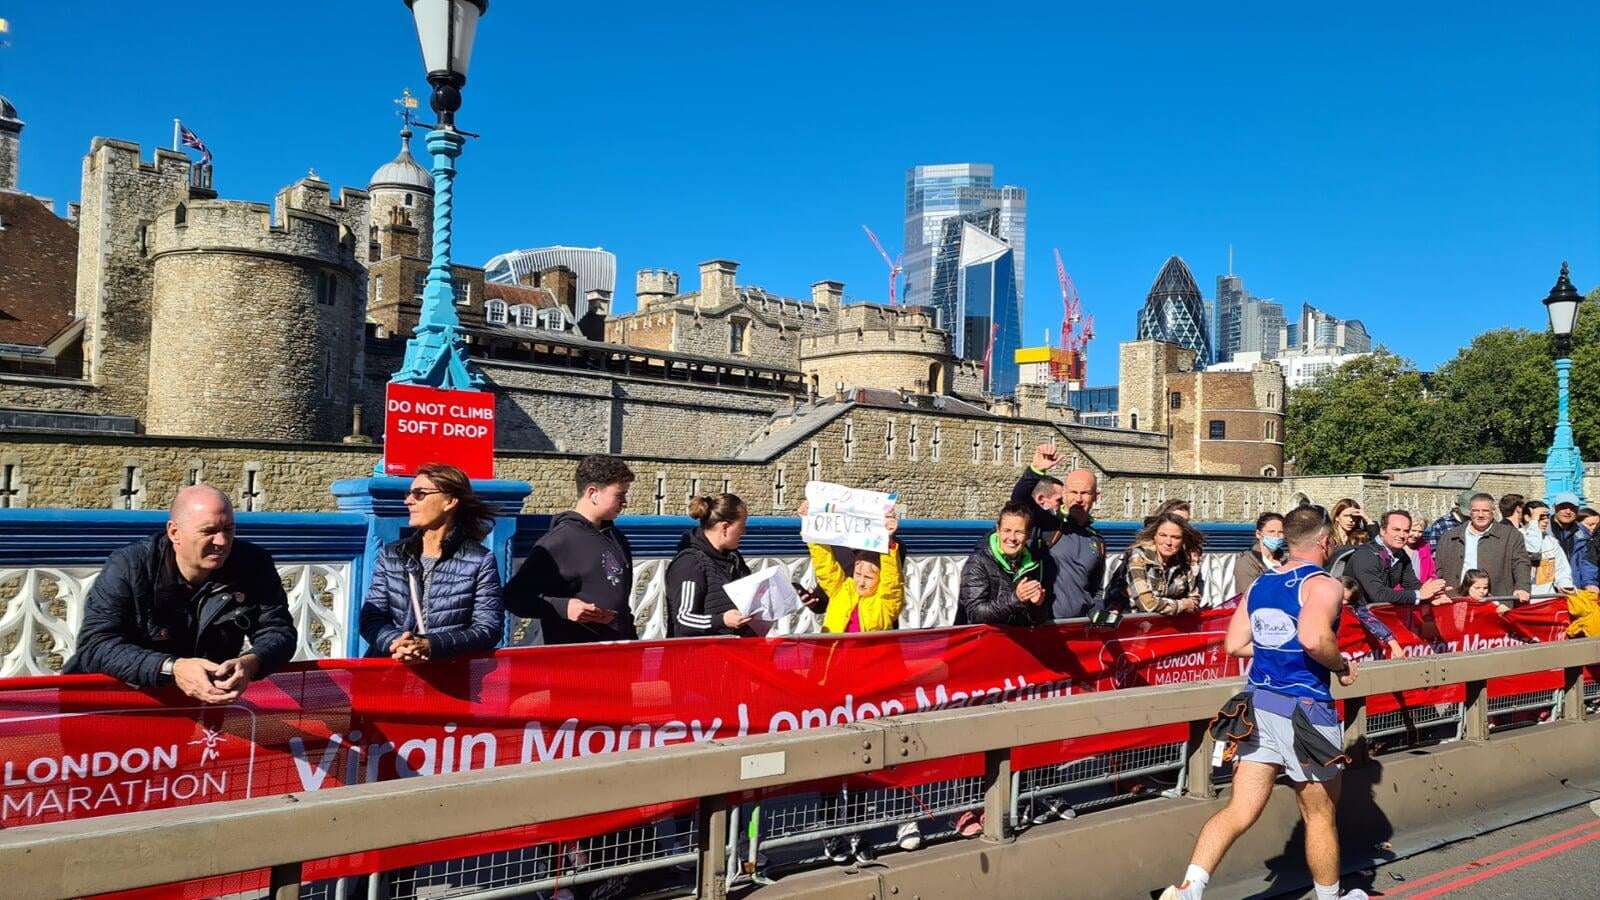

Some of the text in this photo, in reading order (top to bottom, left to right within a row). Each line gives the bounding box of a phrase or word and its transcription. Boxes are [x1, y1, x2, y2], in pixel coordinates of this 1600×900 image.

[388, 400, 493, 420] DO NOT CLIMB
[398, 419, 488, 438] 50FT DROP
[806, 514, 872, 534] FOREVER
[1156, 651, 1205, 670] LONDON
[1155, 667, 1219, 686] MARATHON
[4, 744, 178, 786] LONDON
[289, 722, 497, 792] Virgin
[2, 770, 227, 820] MARATHON
